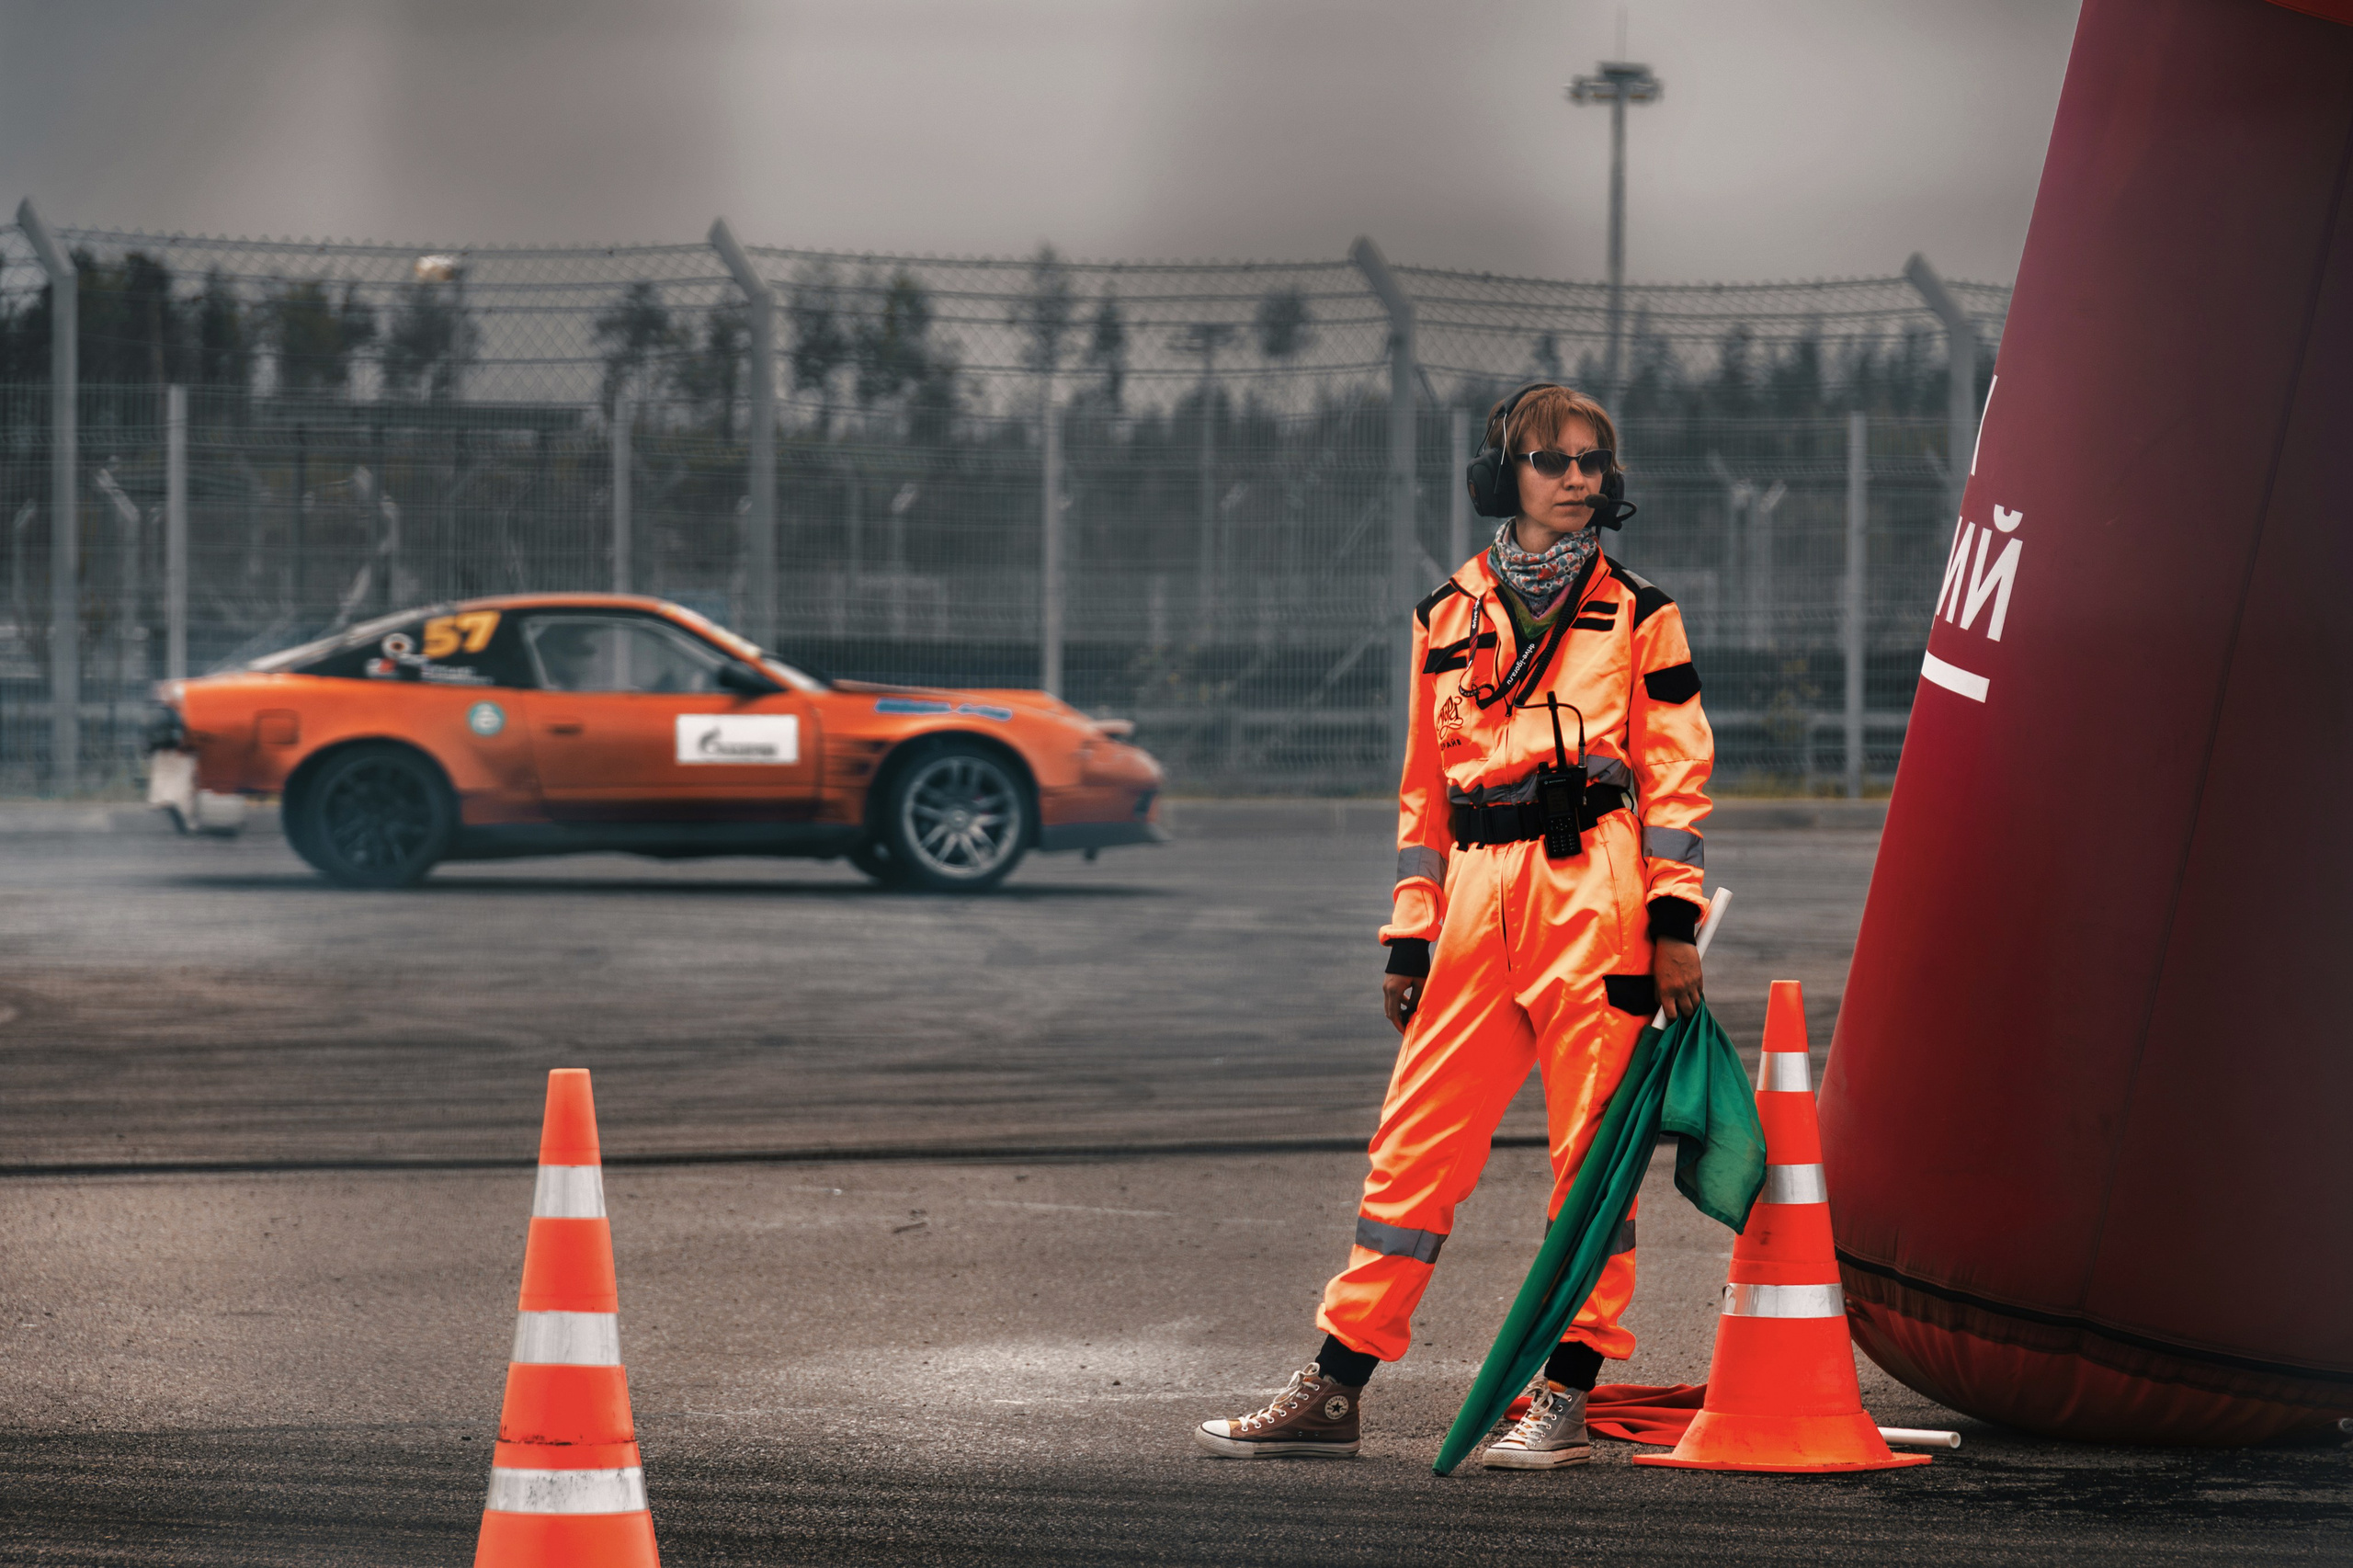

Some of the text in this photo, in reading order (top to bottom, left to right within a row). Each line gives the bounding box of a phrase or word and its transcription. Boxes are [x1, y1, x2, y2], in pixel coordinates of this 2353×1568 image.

[1934, 504, 2023, 642] ИЙ
[423, 610, 501, 658] 57
[1506, 643, 1535, 685] drive-igora.ru
